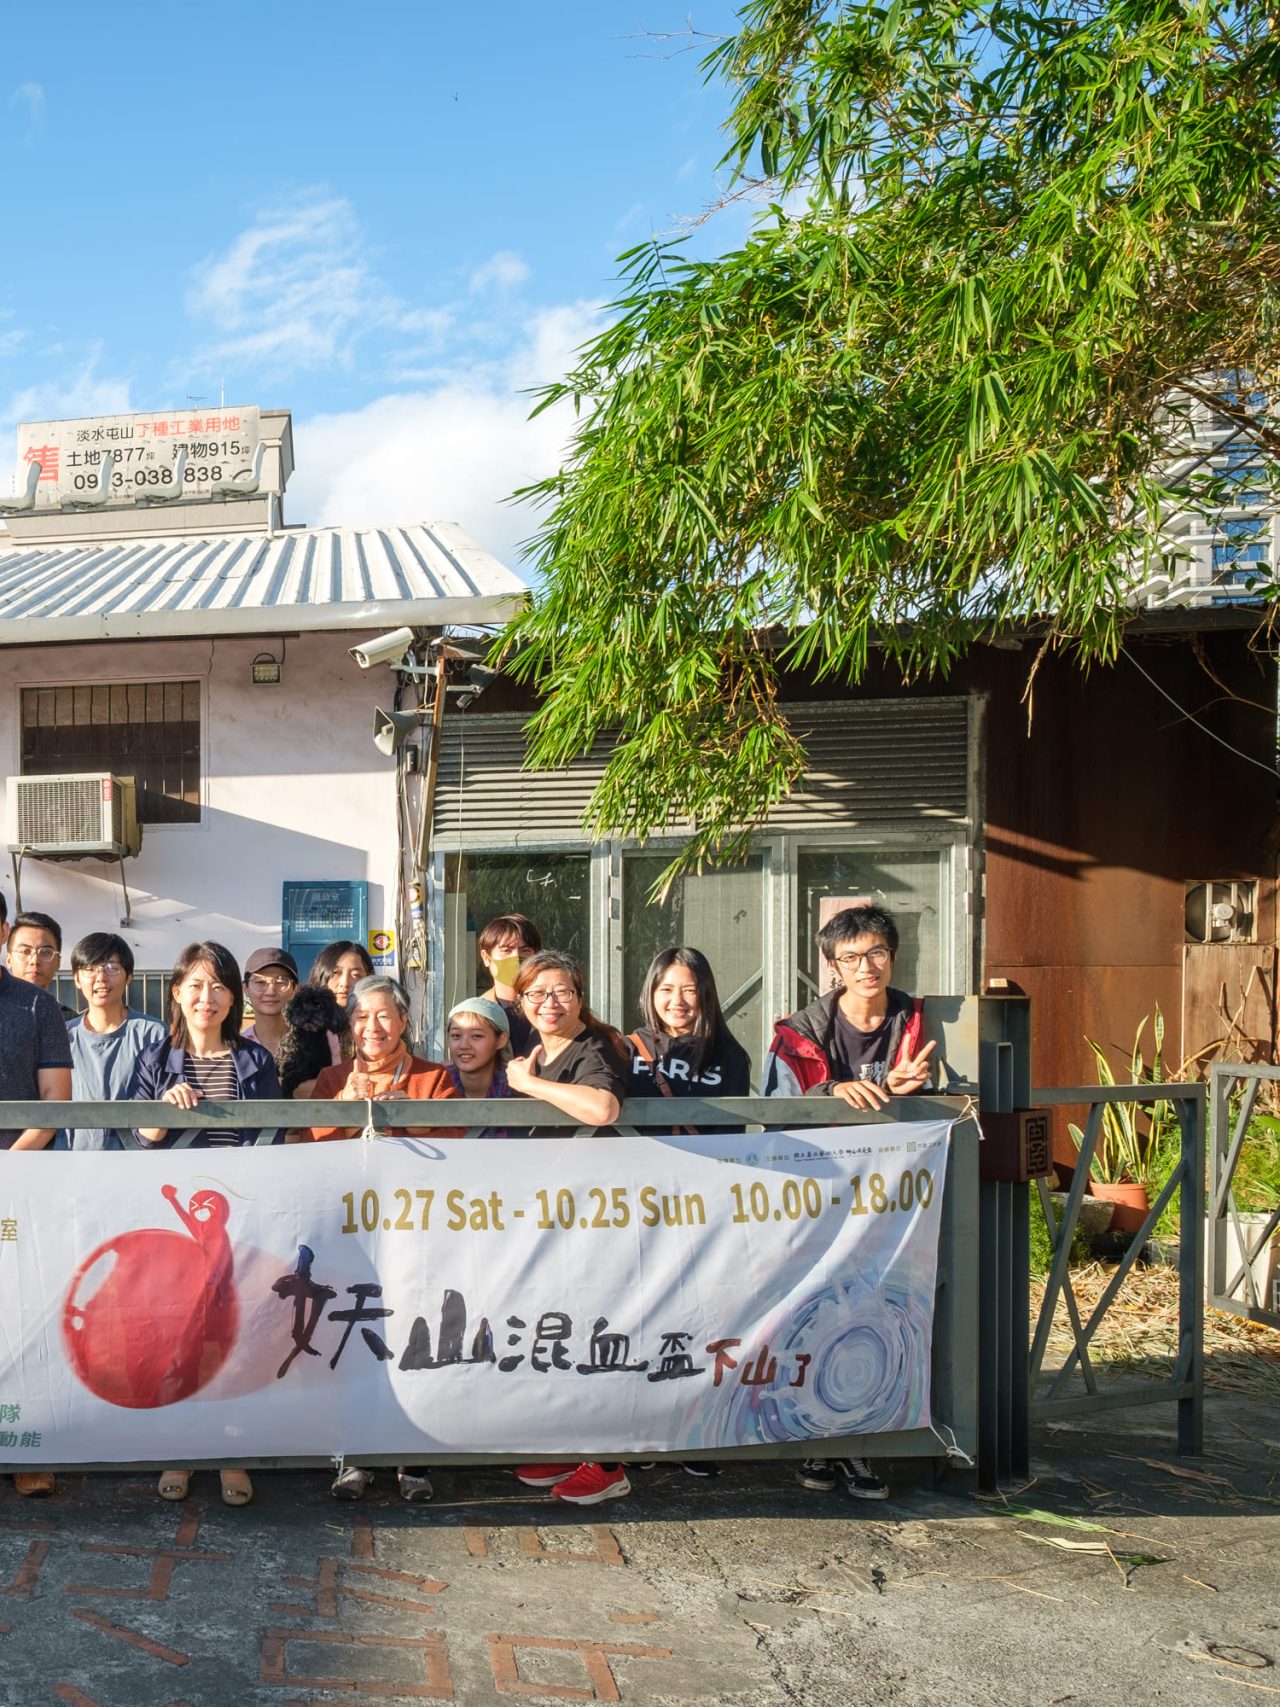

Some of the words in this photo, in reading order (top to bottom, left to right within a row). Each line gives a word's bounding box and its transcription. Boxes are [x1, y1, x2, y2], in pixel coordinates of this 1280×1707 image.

[76, 415, 240, 443] 淡水屯山丁種工業用地
[341, 1189, 435, 1234] 10.27
[446, 1189, 506, 1233] Sat
[536, 1187, 632, 1231] 10.25
[641, 1185, 708, 1229] Sun
[730, 1178, 822, 1225] 10.00
[850, 1168, 933, 1217] 18.00
